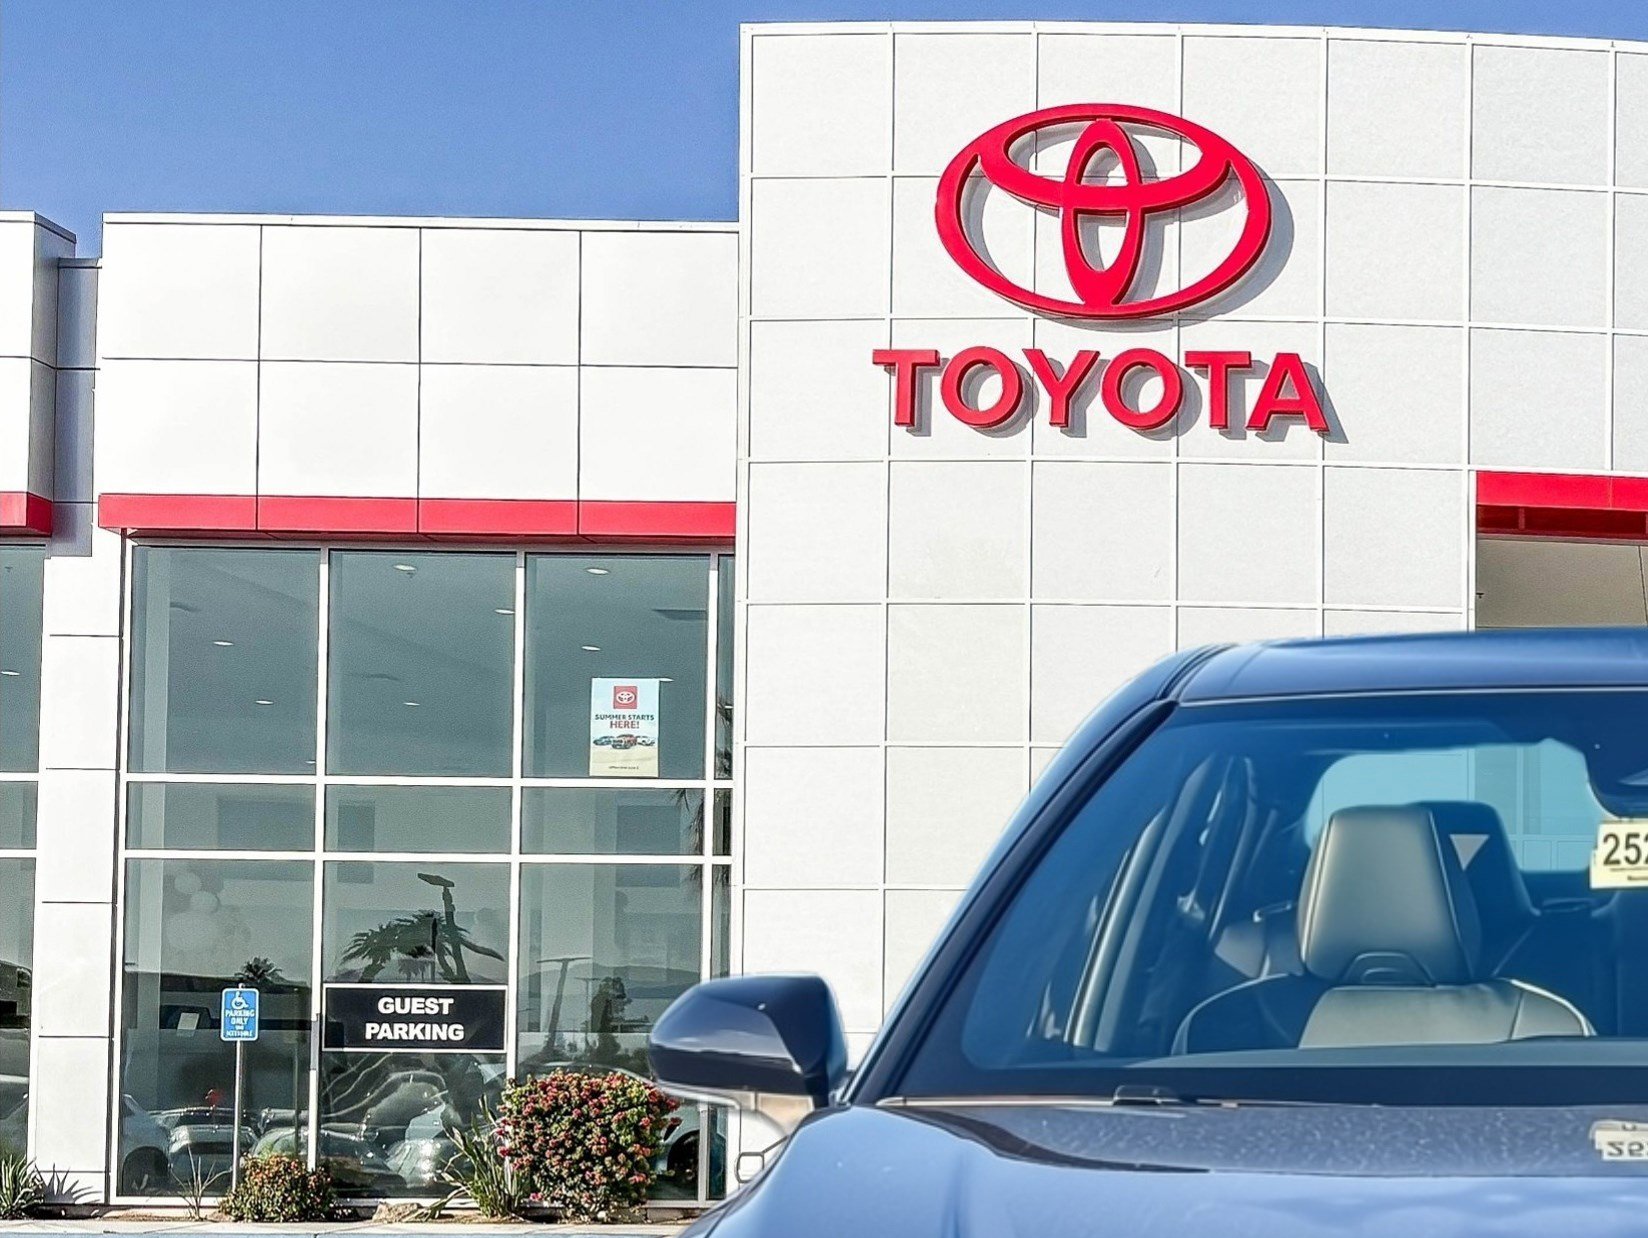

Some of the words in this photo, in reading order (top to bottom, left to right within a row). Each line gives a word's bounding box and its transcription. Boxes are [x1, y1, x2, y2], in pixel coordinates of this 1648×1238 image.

[872, 346, 1330, 433] TOYOTA
[609, 720, 640, 729] HERE!
[225, 1009, 255, 1018] PARKING
[377, 996, 455, 1015] GUEST
[364, 1022, 465, 1041] PARKING
